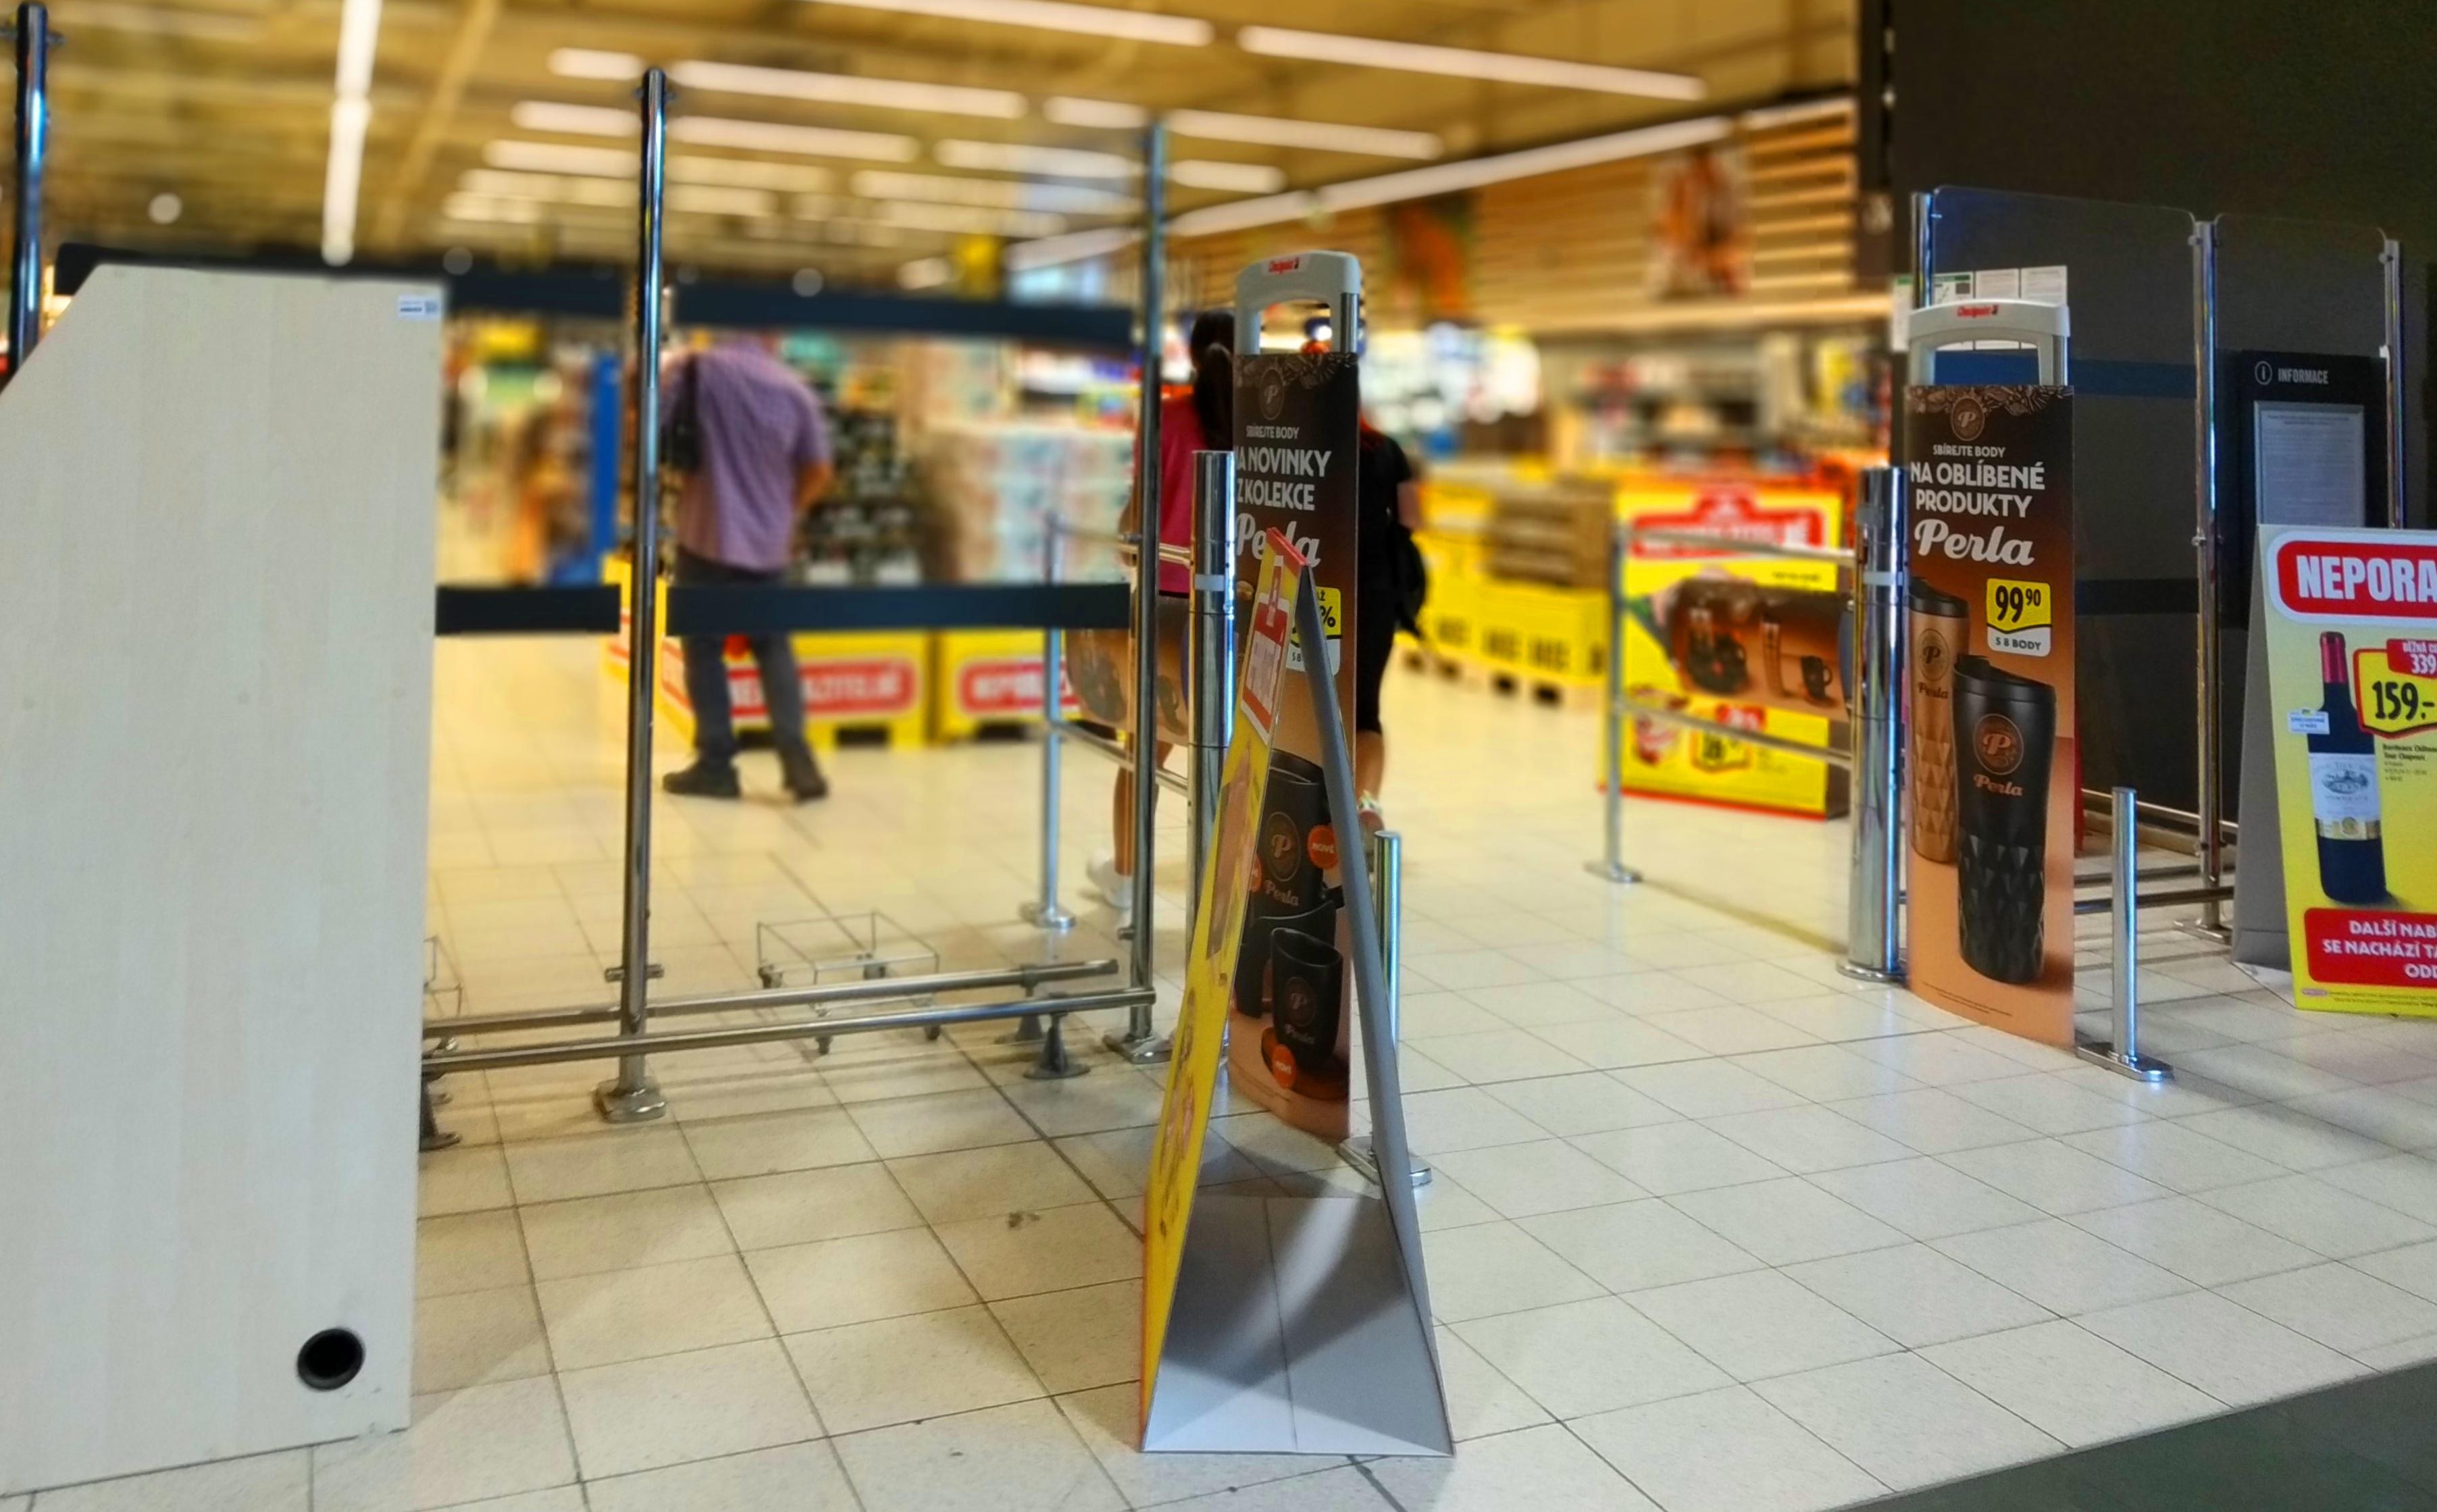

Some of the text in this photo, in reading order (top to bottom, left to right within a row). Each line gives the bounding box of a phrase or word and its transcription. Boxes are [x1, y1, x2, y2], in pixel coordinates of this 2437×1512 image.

[2278, 368, 2329, 384] INFORMACE
[1276, 427, 1300, 439] BODY
[1248, 446, 1332, 477] NOVINKY
[1933, 443, 2006, 458] SBÍREJTE BODY
[1910, 459, 2046, 490] NA OBLÍBENÉ
[1245, 479, 1315, 511] KOLEKCE
[1916, 488, 2032, 518] PRODUKTY
[1236, 513, 1321, 567] Pela
[1914, 519, 2035, 566] Perla
[2003, 637, 2010, 647] 8
[2012, 639, 2041, 650] BODY
[1918, 682, 1949, 700] Perla
[1973, 774, 2024, 797] Perla
[1264, 879, 1299, 906] Perla
[2349, 919, 2397, 937] DALŠÍ
[2323, 939, 2342, 954] SE
[2344, 939, 2421, 958] NACHÁZÍ
